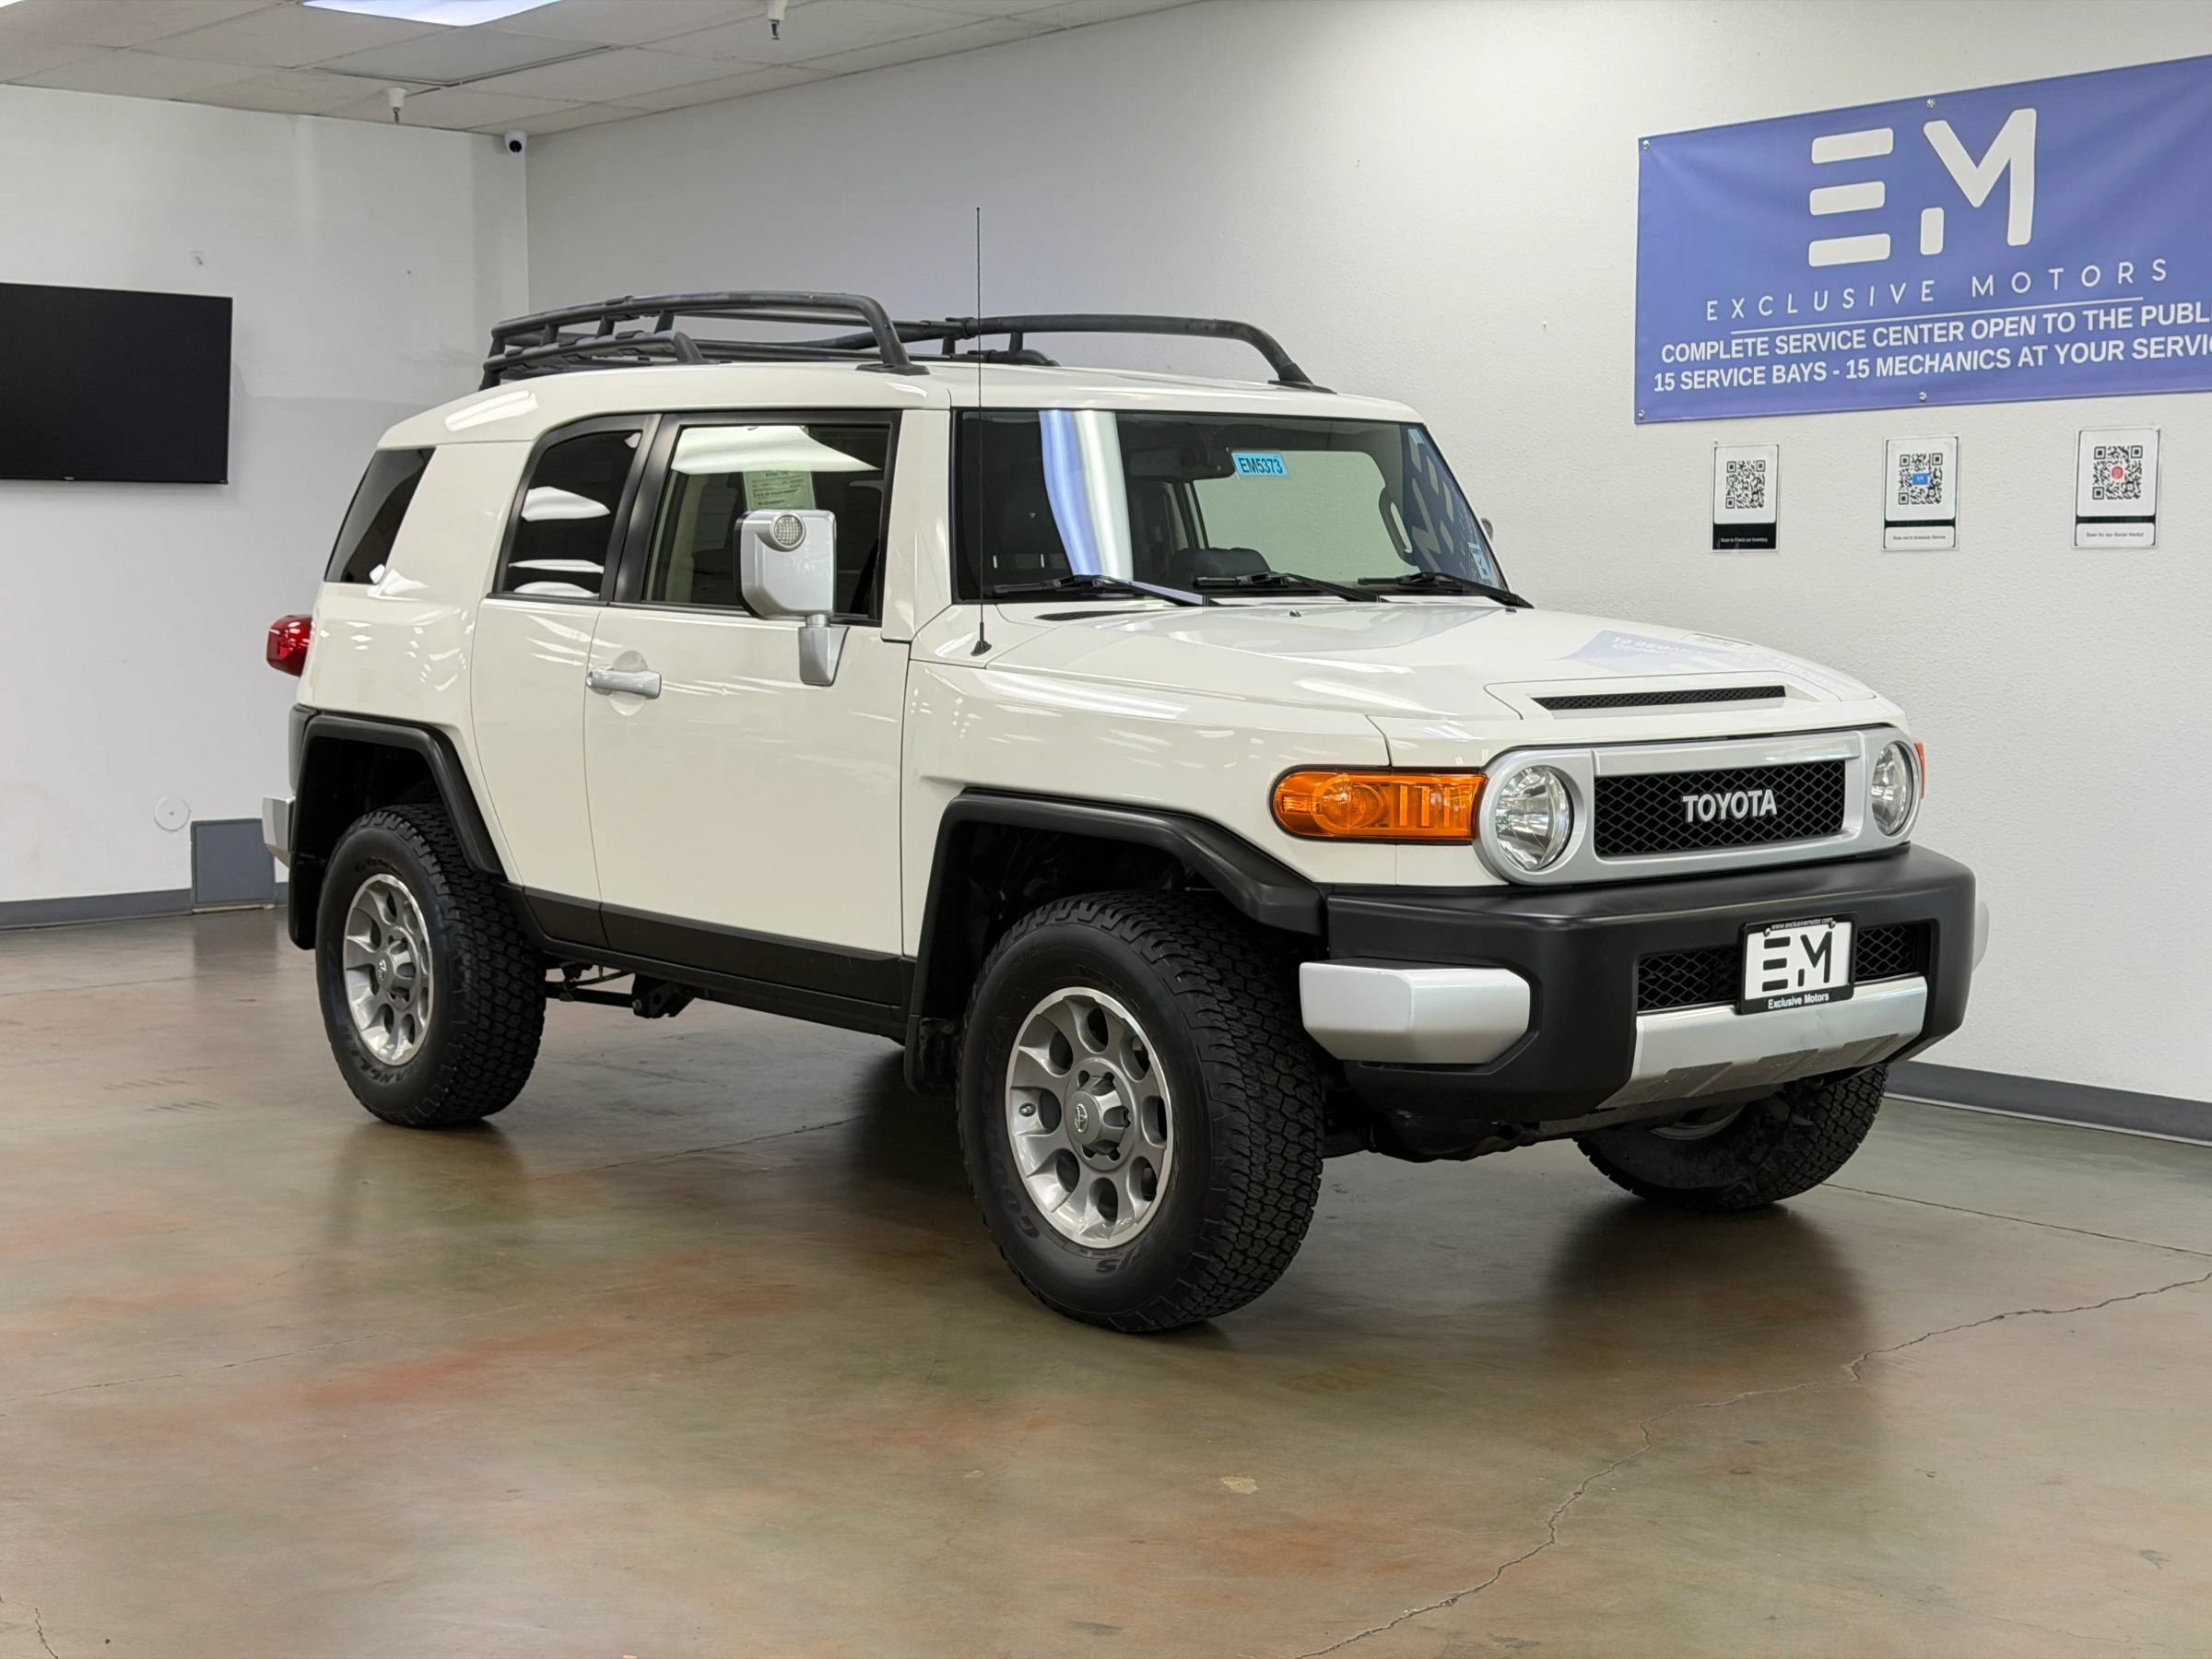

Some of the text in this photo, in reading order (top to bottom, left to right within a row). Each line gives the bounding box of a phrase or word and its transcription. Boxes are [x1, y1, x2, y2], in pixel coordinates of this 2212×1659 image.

[1807, 107, 2038, 267] EM
[1706, 257, 2168, 322] EXCLUSIVE MOTORS
[1661, 301, 2212, 363] COMPLETE SERVICE CENTER OPEN TO THE PUBL
[1653, 372, 1676, 392] 15
[1680, 365, 1766, 391] SERVICE
[1772, 361, 1827, 384] BAYS
[1845, 358, 1870, 380] 15
[1876, 347, 2011, 378] MECHANICS
[2018, 345, 2048, 368] AT
[2054, 339, 2124, 365] YOUR
[2131, 333, 2212, 360] SERVI
[1238, 457, 1283, 474] EM5373
[1682, 789, 1778, 824] TOYOTA
[1762, 931, 1833, 993] EM
[1768, 993, 1830, 1009] Exclusive Motors
